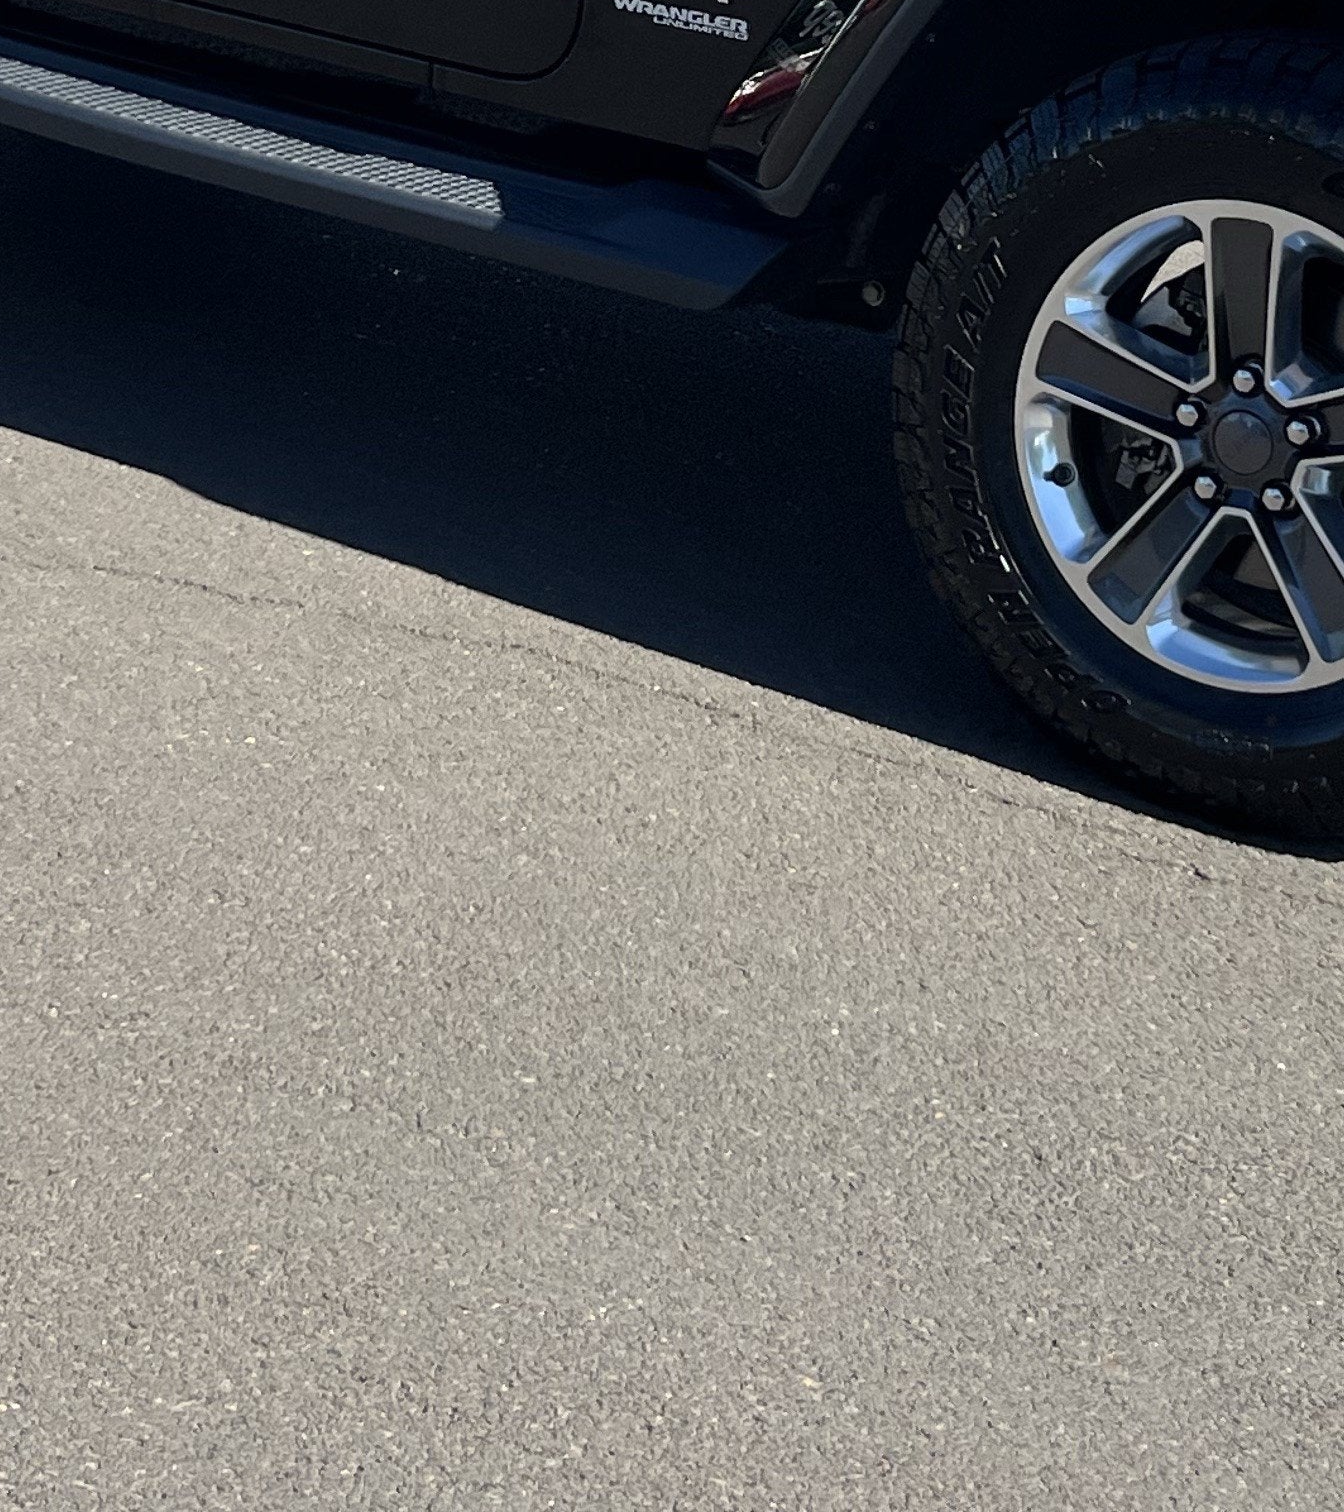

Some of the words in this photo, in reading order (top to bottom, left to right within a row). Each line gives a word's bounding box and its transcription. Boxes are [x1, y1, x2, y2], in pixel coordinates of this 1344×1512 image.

[653, 15, 749, 41] UNLIMITED
[955, 234, 1009, 348] A/T
[938, 344, 1014, 576] RANGE
